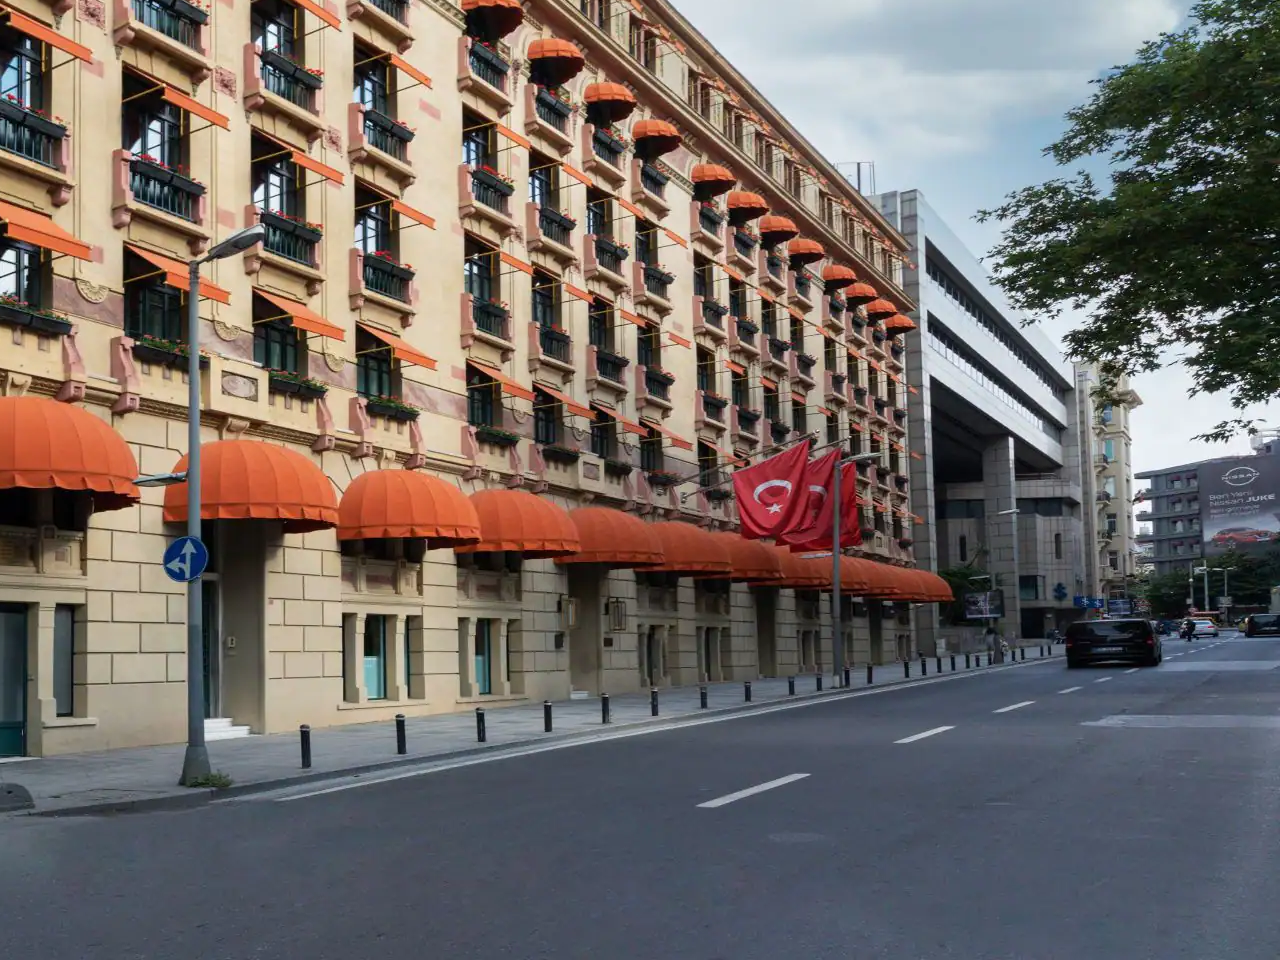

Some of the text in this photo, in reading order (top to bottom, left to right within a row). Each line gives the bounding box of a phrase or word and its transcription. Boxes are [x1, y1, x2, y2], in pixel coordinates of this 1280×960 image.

[1221, 471, 1260, 481] NISSAN
[1210, 494, 1276, 507] Nissan JUKE
